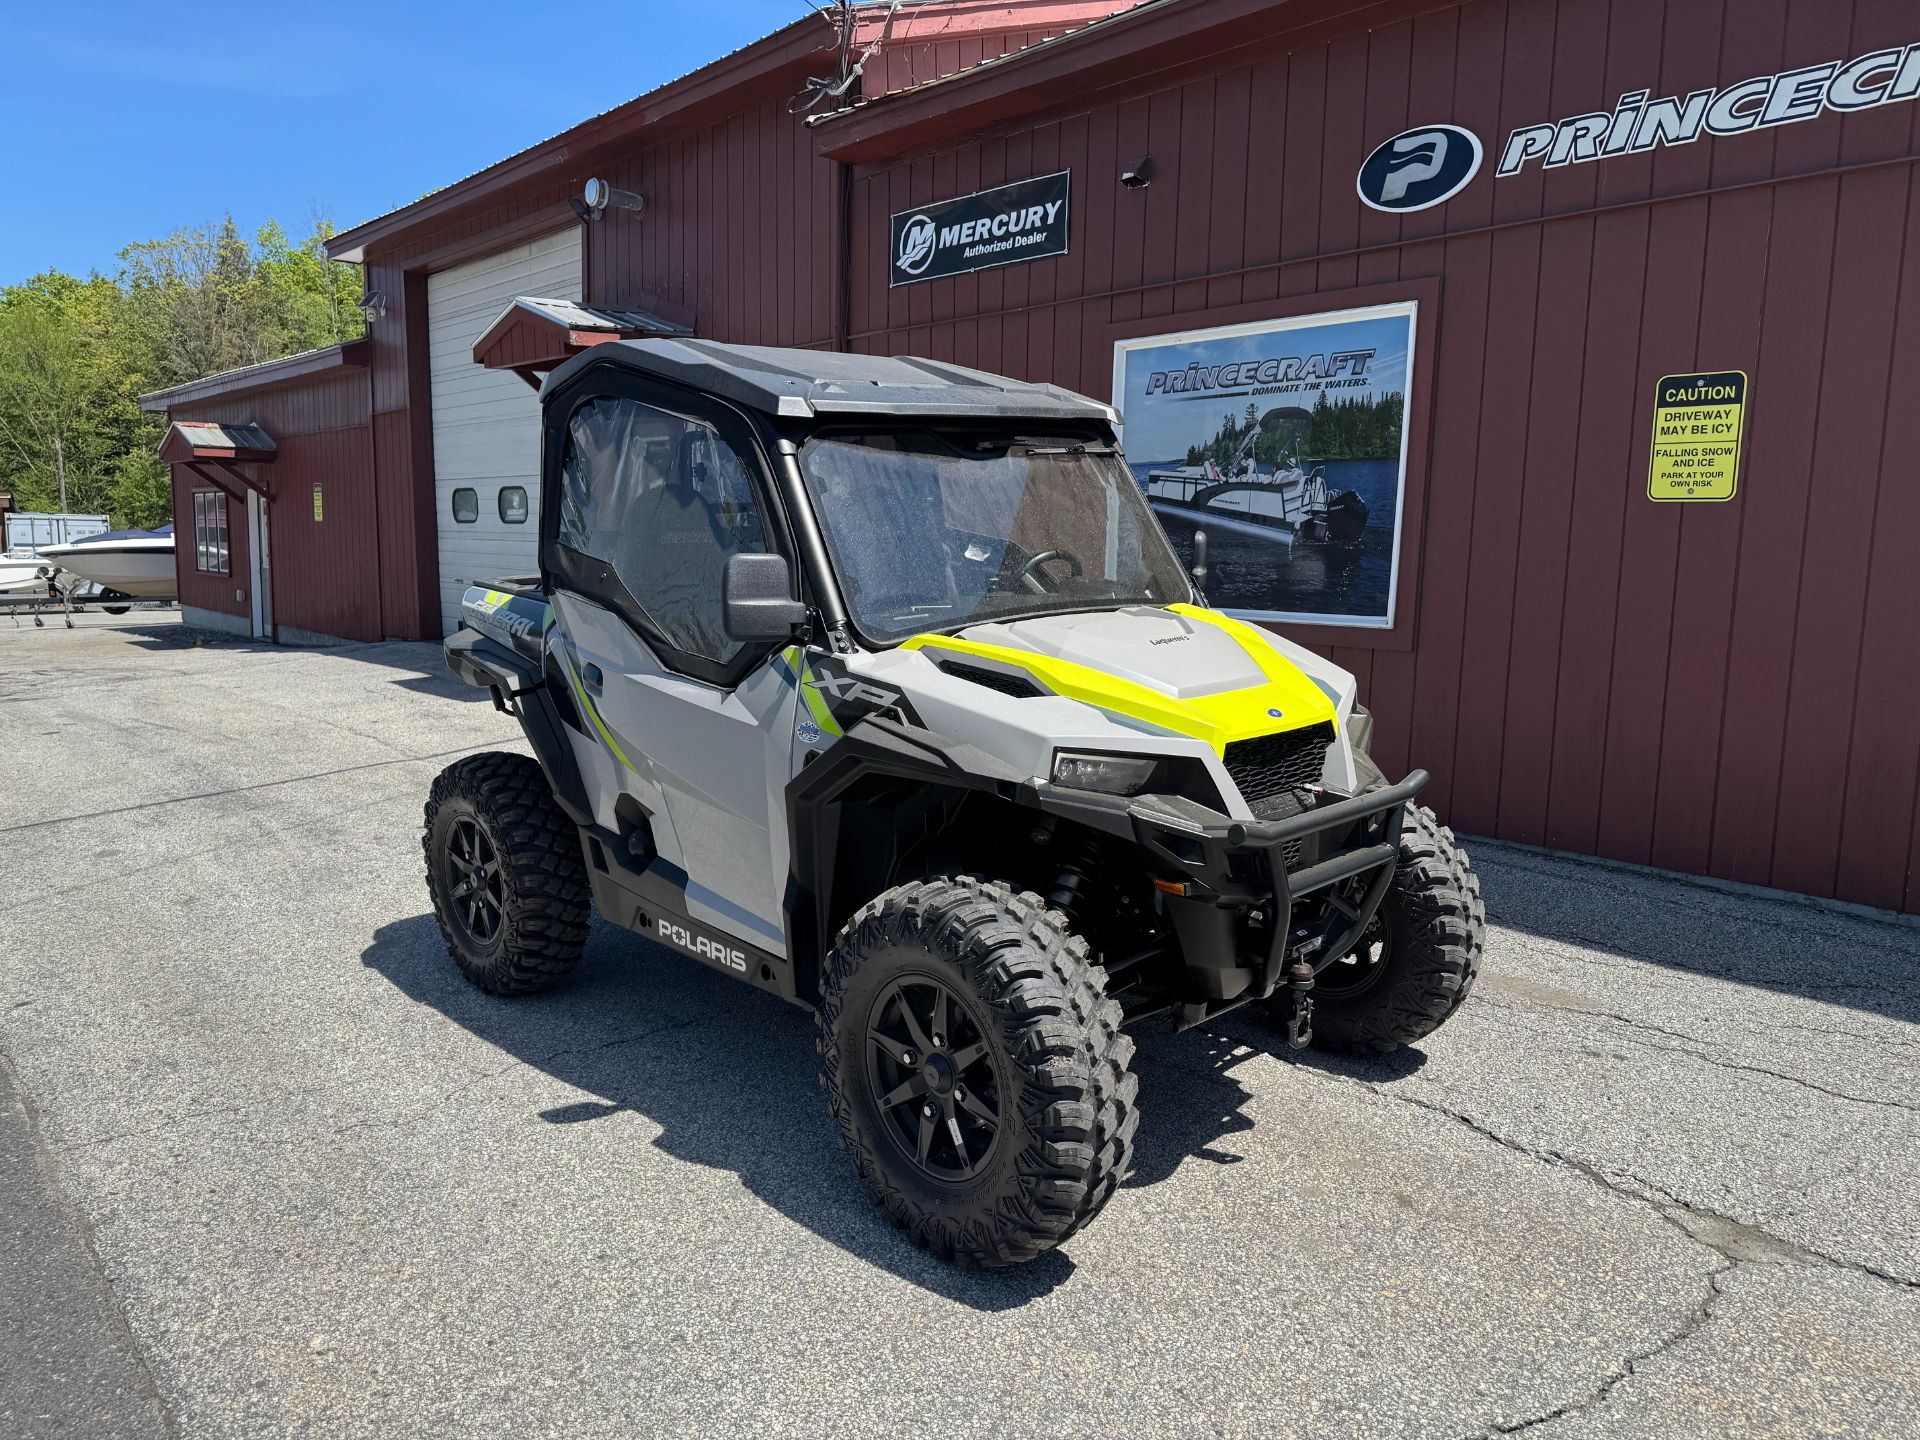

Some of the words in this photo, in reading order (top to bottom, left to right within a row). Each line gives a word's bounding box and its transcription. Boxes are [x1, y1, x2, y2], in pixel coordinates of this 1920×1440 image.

[938, 199, 1063, 249] MERCURY
[963, 237, 1013, 259] Authorized
[1014, 231, 1047, 248] Dealer
[1251, 383, 1301, 396] DOMINATE
[1303, 382, 1322, 391] THE
[1325, 378, 1368, 389] WATERS
[1665, 385, 1736, 402] CAUTION
[1664, 409, 1732, 422] DRIVEWAY
[1660, 425, 1688, 436] MAY
[1691, 424, 1708, 435] BE
[1712, 423, 1733, 434] ICY
[1656, 448, 1699, 458] FALLING
[1701, 447, 1734, 456] SNOW
[1672, 459, 1695, 468] AND
[1697, 458, 1715, 467] ICE
[1670, 480, 1690, 488] OWN
[658, 918, 747, 972] POLARIS
